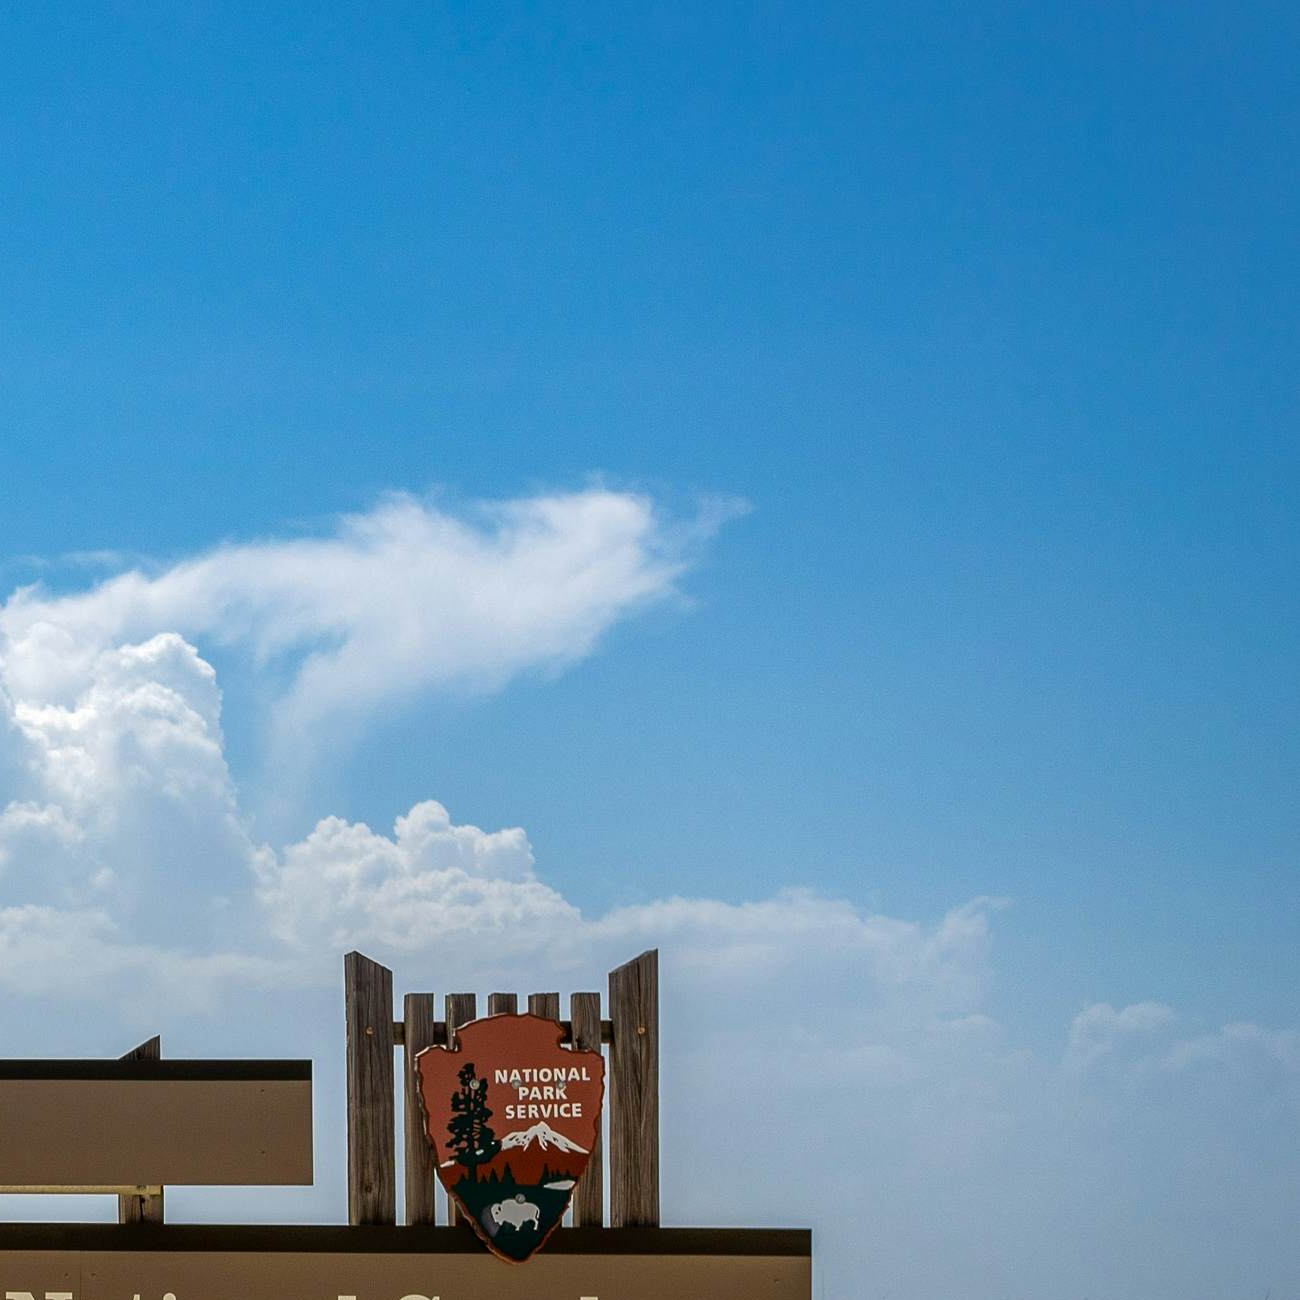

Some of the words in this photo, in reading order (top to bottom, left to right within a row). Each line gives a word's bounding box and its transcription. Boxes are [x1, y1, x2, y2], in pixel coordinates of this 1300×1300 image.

[494, 1067, 591, 1084] NATIONAL
[518, 1085, 568, 1101] PARK
[505, 1103, 583, 1120] SERVICE
